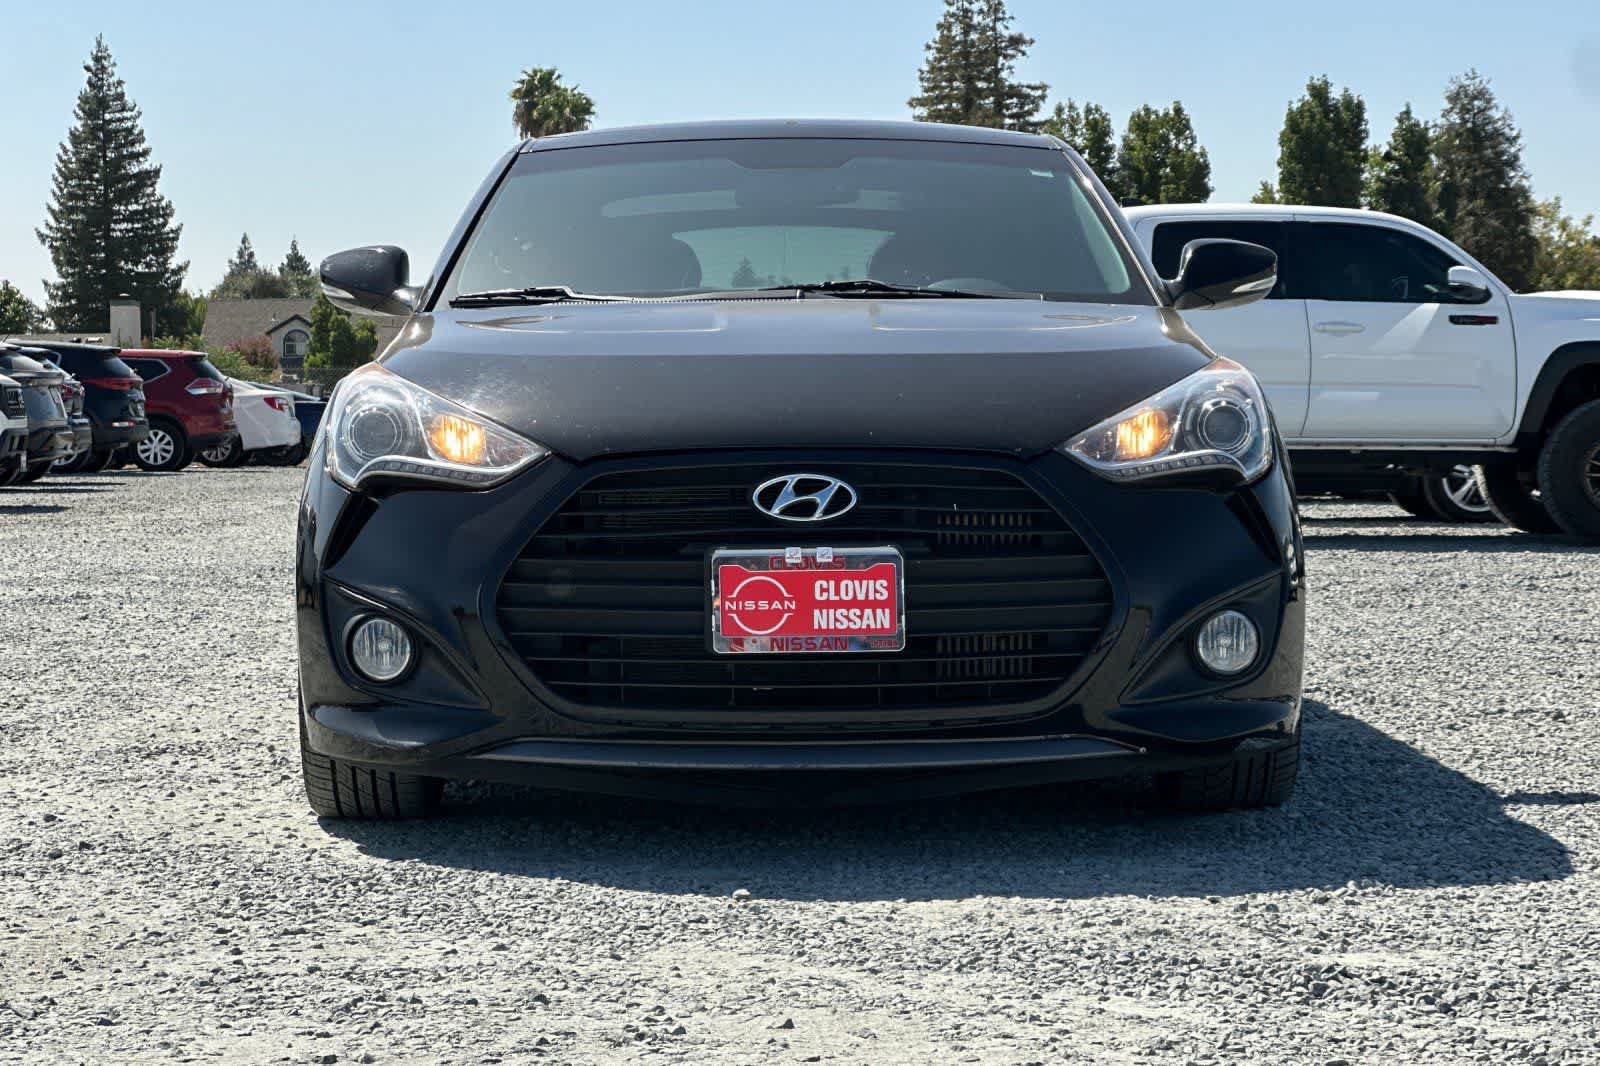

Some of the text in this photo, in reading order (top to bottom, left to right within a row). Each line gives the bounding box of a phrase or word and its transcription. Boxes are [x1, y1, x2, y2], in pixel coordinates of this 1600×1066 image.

[814, 579, 888, 601] CLOVIS
[725, 600, 796, 610] NISSAN
[813, 608, 890, 630] NISSAN
[770, 637, 848, 652] NISSAN
